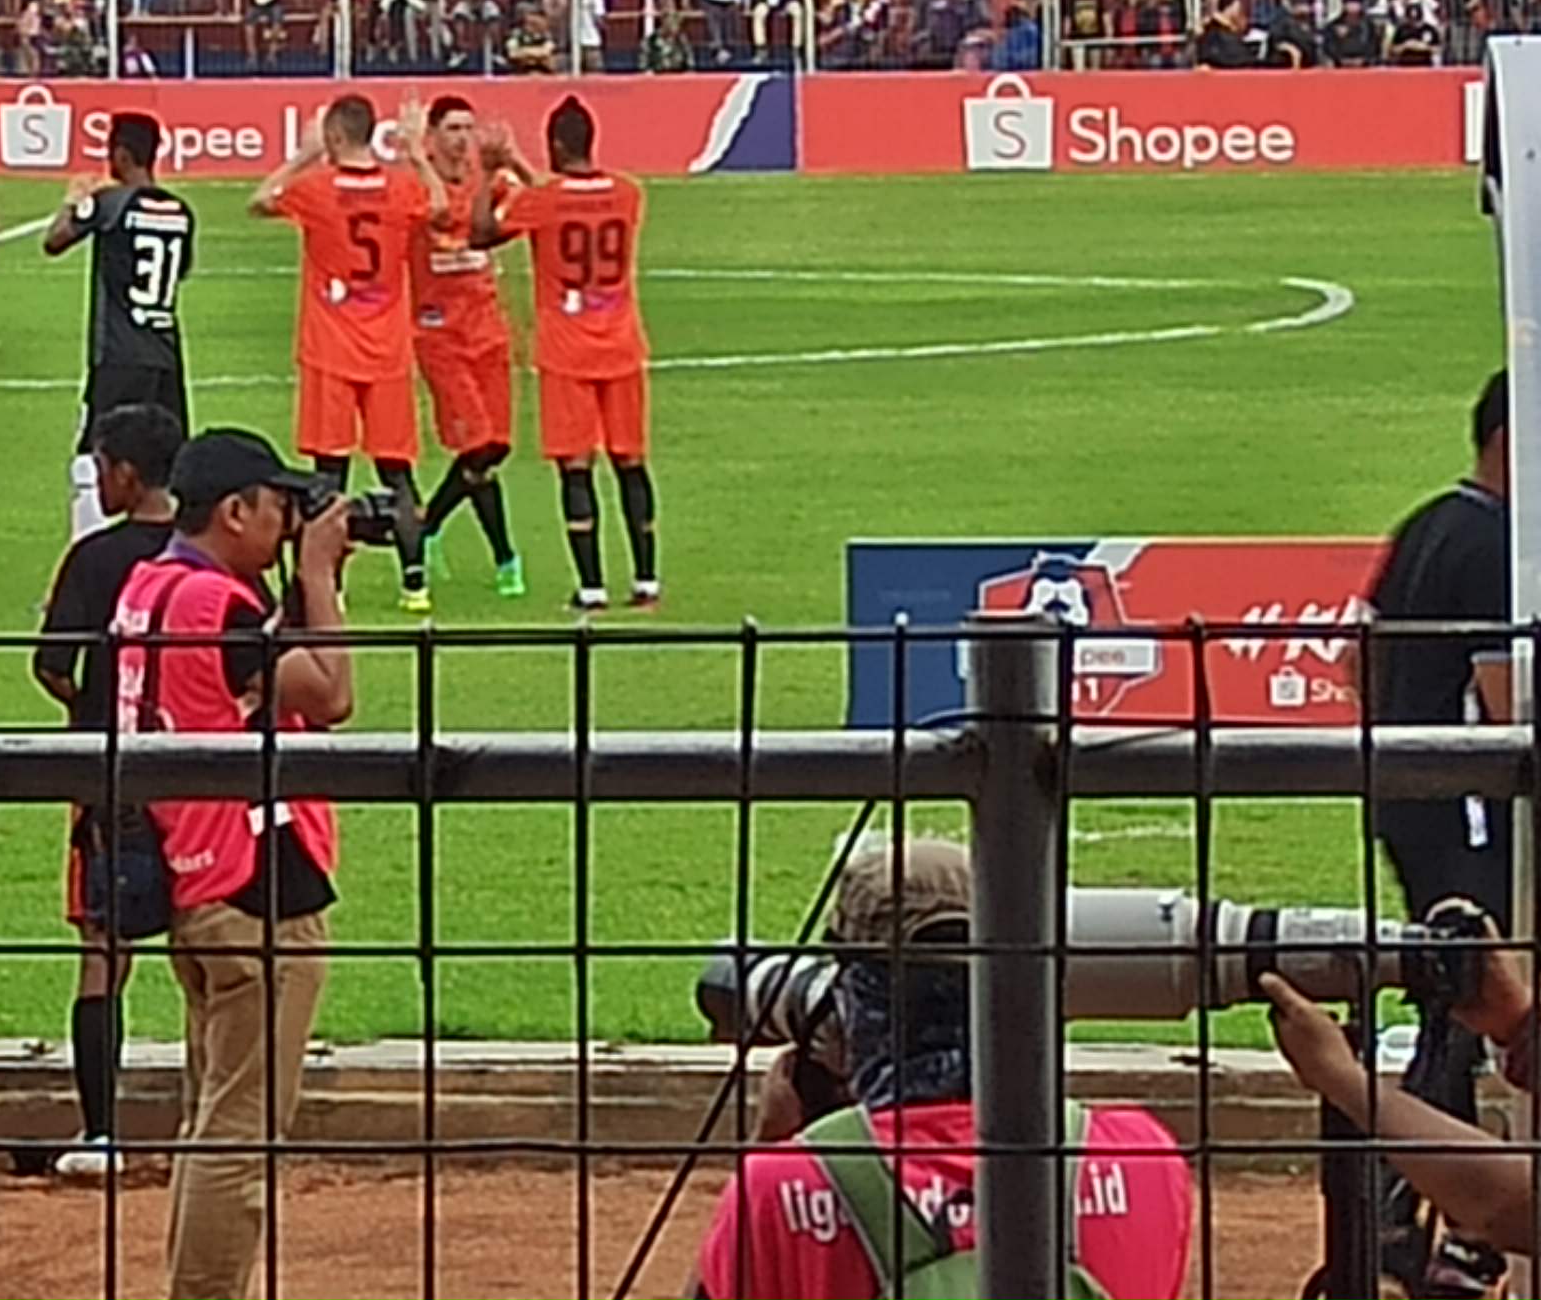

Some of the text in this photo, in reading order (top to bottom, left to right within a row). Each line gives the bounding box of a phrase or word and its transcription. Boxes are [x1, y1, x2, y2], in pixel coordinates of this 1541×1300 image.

[1068, 107, 1295, 167] Shopee
[128, 234, 182, 308] 31
[348, 211, 381, 282] 5
[559, 217, 626, 289] 99
